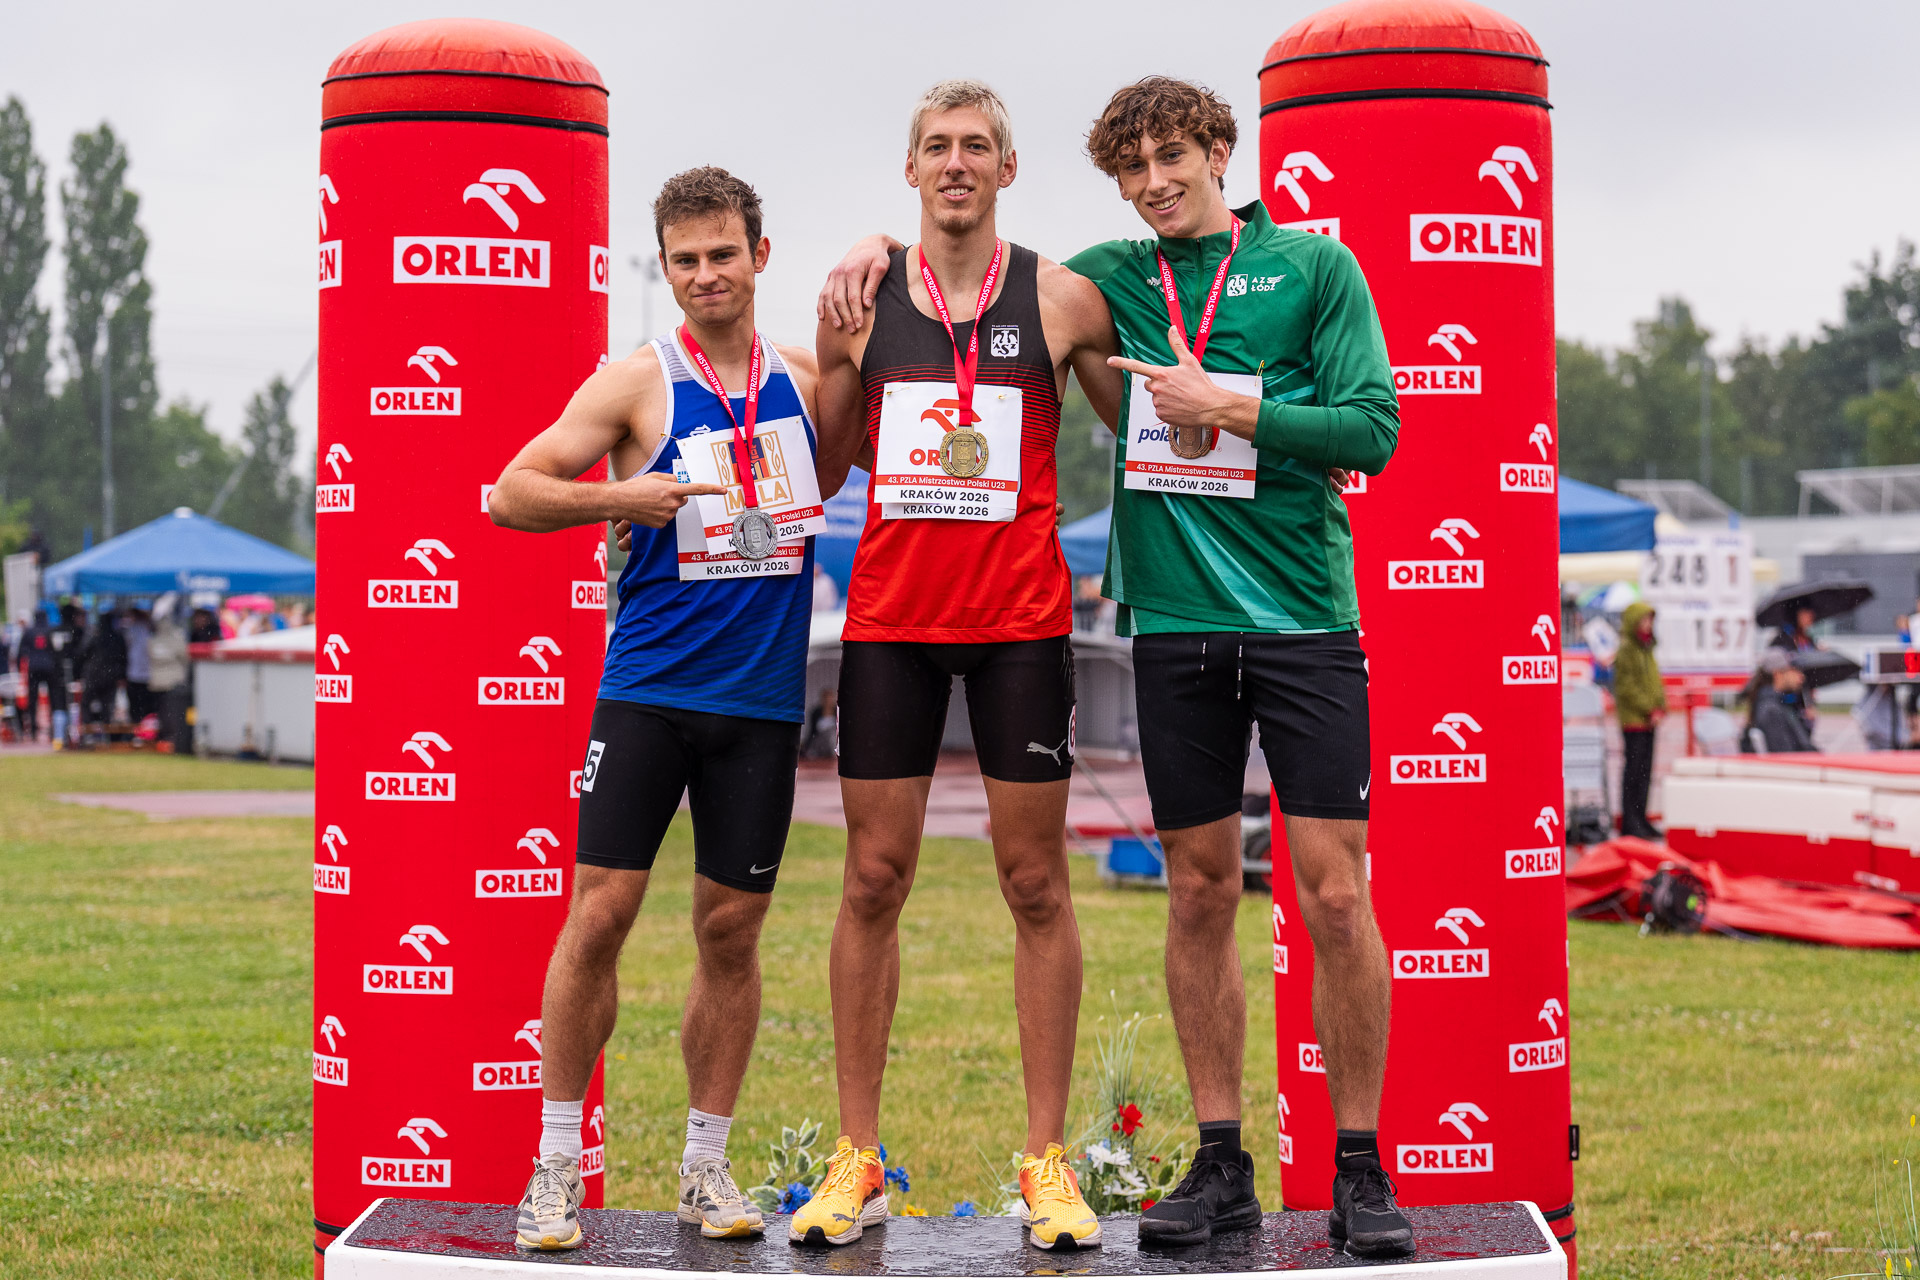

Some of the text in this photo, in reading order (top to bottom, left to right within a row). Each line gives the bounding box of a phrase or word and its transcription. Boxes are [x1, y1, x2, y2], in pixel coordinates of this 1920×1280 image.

[1419, 221, 1536, 258] ORLEN
[402, 243, 541, 280] ORLEN
[921, 266, 945, 311] MISTRZOSTWA
[1205, 291, 1219, 315] POLSKI
[1200, 316, 1211, 334] 2026
[695, 352, 725, 396] MISTRZOSTWA
[748, 358, 760, 403] MISTRZOSTWA
[1395, 370, 1475, 390] ORLEN
[375, 391, 455, 412] ORLEN
[1136, 463, 1147, 471] 43.
[1148, 464, 1164, 472] PZLA
[1165, 466, 1207, 476] Mistrzostwa
[1208, 469, 1229, 477] Polski
[1505, 468, 1552, 488] ORLEN
[888, 476, 899, 484] 43.
[919, 477, 966, 486] Mistrzostwa
[967, 479, 990, 488] Polski
[991, 481, 1006, 489] U23
[1148, 477, 1229, 492] KRAKÓW 2026
[316, 489, 350, 508] ORLEN
[728, 481, 788, 511] MLA
[900, 488, 990, 503] KRAKÓW 2026
[903, 504, 989, 516] KRAKÓW 2026
[714, 526, 725, 535] 43.
[782, 511, 801, 522] Polski
[801, 508, 814, 518] U23
[779, 524, 805, 537] 2026
[773, 548, 788, 556] olski
[706, 561, 790, 575] KRAKÓW 2026
[1394, 565, 1478, 585] ORLEN
[372, 584, 452, 604] ORLEN
[1507, 660, 1556, 680] ORLEN
[484, 681, 560, 701] ORLEN
[584, 750, 600, 783] 5
[1396, 759, 1480, 779] ORLEN
[370, 776, 450, 797] ORLEN
[1510, 852, 1559, 874] ORLEN
[481, 872, 558, 893] ORLEN
[1399, 953, 1483, 974] ORLEN
[367, 969, 447, 990] ORLEN
[1514, 1041, 1563, 1068] ORLEN
[479, 1065, 541, 1087] ORLE
[1403, 1147, 1488, 1169] ORLEN
[366, 1161, 445, 1183] ORLEN
